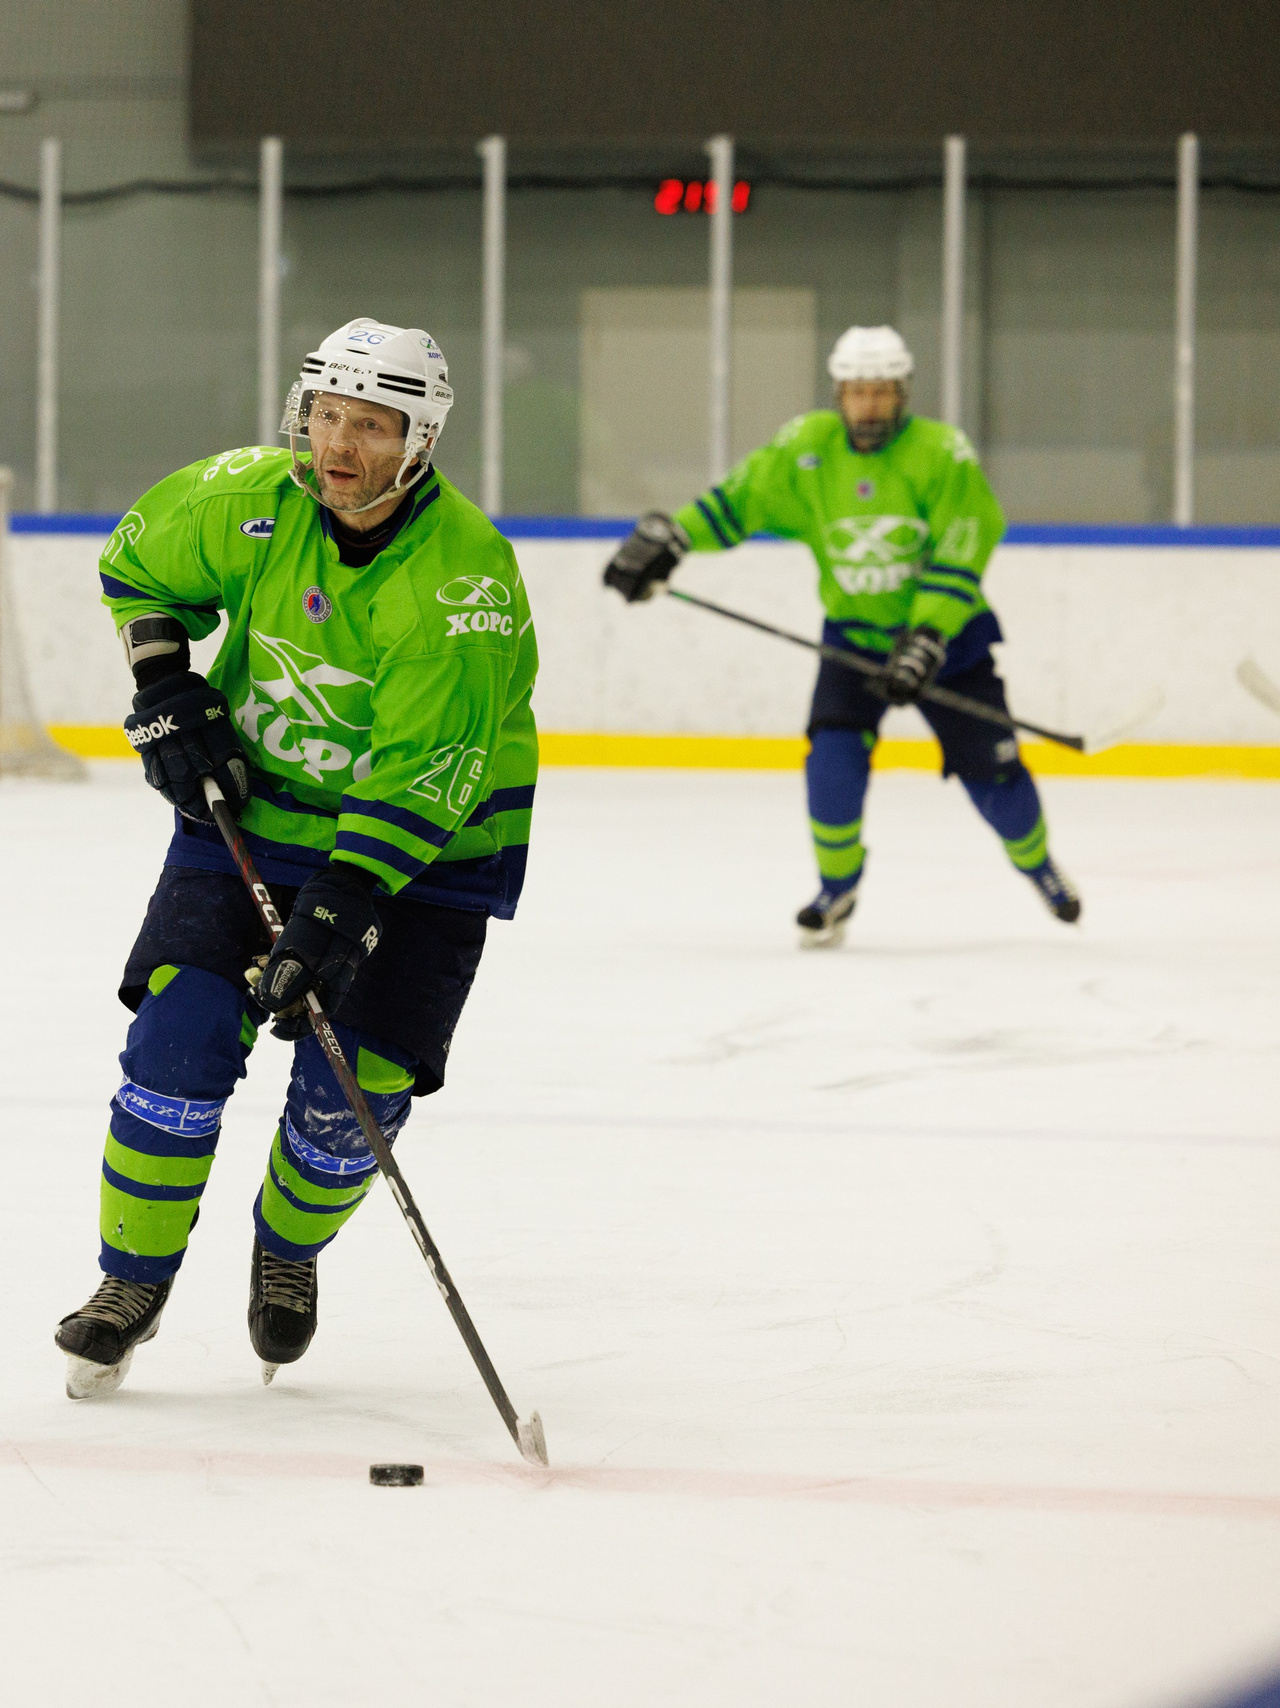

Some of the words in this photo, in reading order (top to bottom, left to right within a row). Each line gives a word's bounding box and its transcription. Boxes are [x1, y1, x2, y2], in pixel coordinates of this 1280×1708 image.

[348, 330, 385, 345] 26
[124, 714, 180, 747] Reebok
[406, 743, 488, 816] 26
